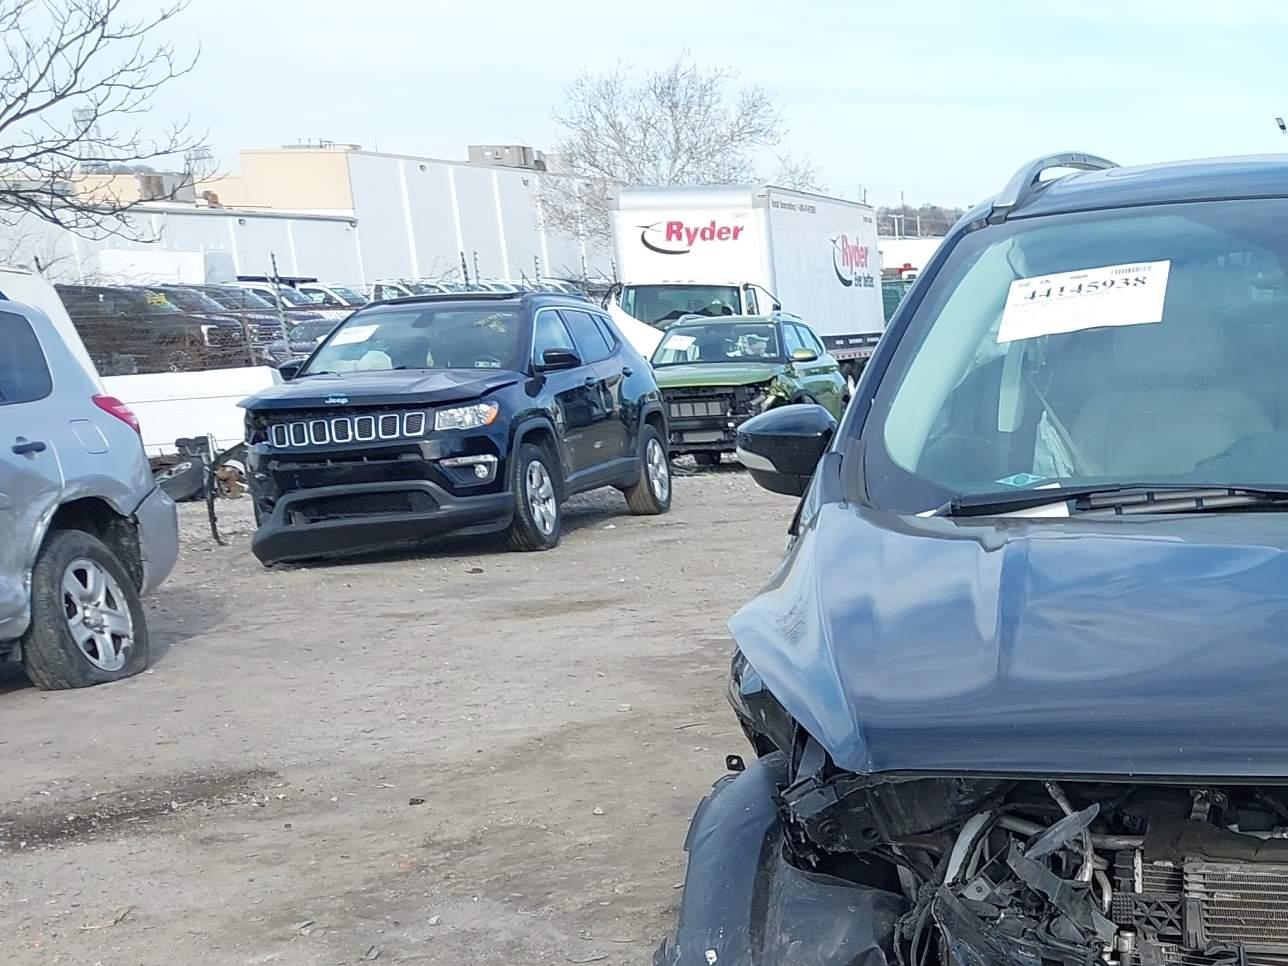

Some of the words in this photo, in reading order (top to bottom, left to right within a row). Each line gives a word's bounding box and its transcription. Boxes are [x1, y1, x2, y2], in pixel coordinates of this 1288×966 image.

[665, 220, 744, 246] Ryder
[841, 234, 869, 275] Ryder
[1024, 275, 1147, 301] 44145938
[324, 397, 349, 405] Jeep
